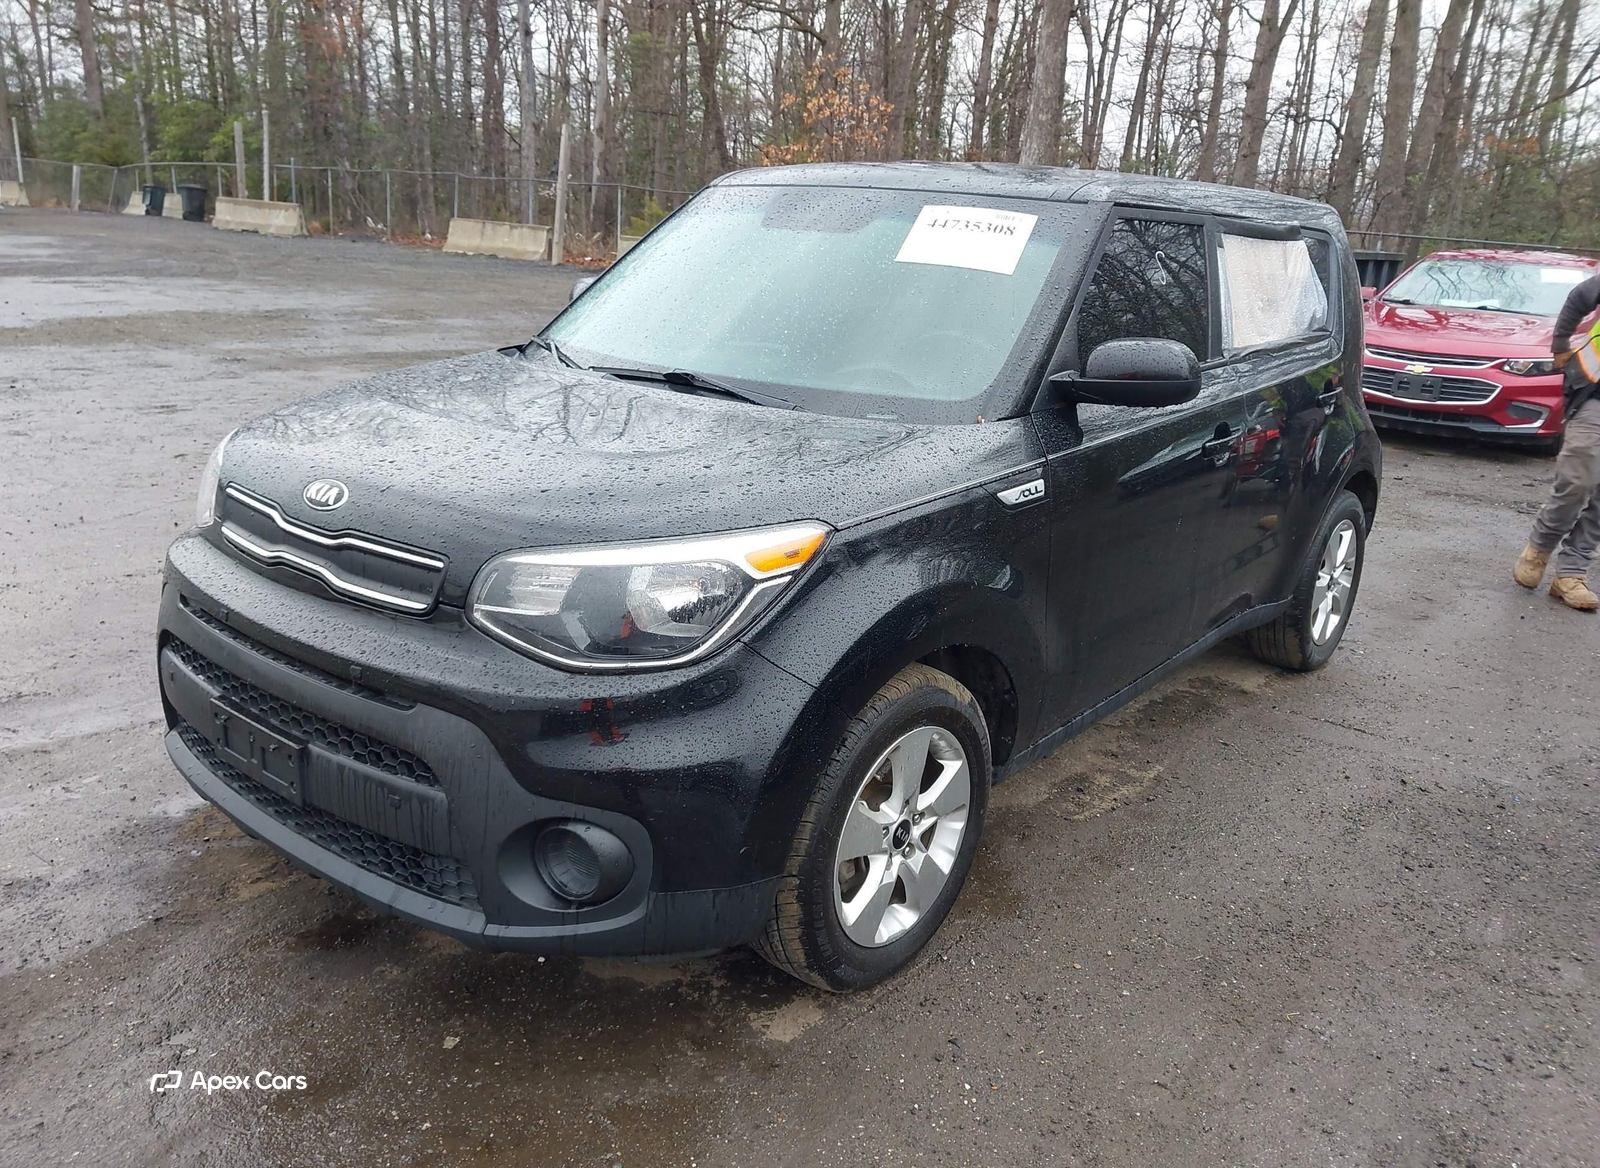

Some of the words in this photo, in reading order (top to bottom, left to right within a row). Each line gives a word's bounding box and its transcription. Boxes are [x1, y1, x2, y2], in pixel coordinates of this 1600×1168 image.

[926, 218, 1017, 237] 44735308
[305, 482, 341, 506] KIA
[1014, 485, 1043, 502] SOUL
[895, 826, 910, 844] KIA
